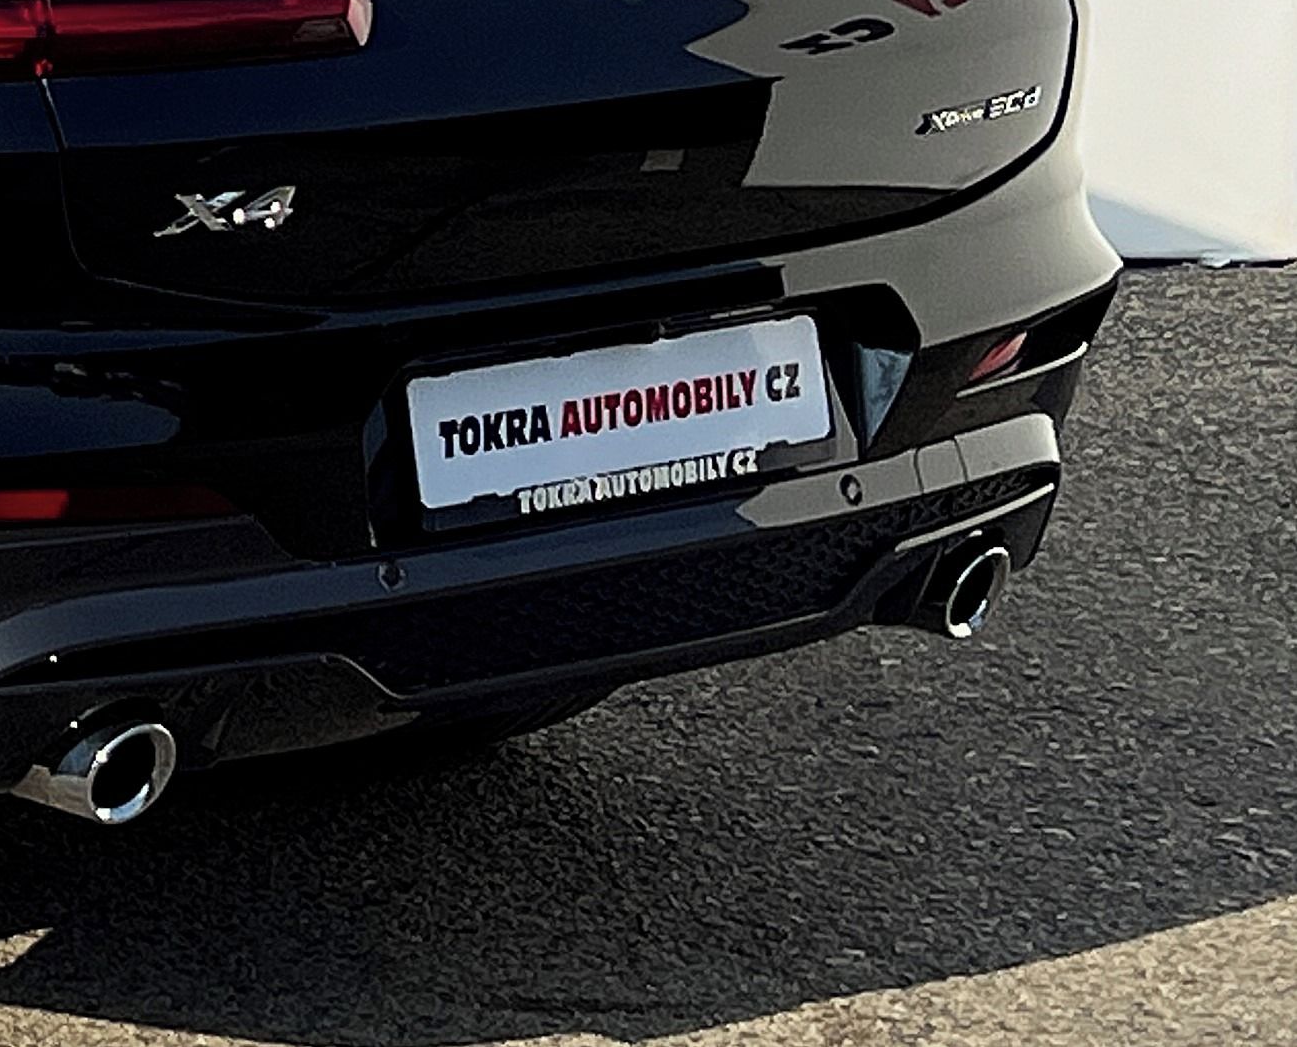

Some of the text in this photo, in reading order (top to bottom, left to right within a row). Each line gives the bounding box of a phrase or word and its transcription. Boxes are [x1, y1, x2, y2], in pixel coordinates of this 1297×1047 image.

[153, 185, 296, 237] X4
[439, 362, 801, 459] TOKRA AUTOMOBILY CZ
[518, 450, 758, 514] TOKRA AUTOMOBILY CZ
